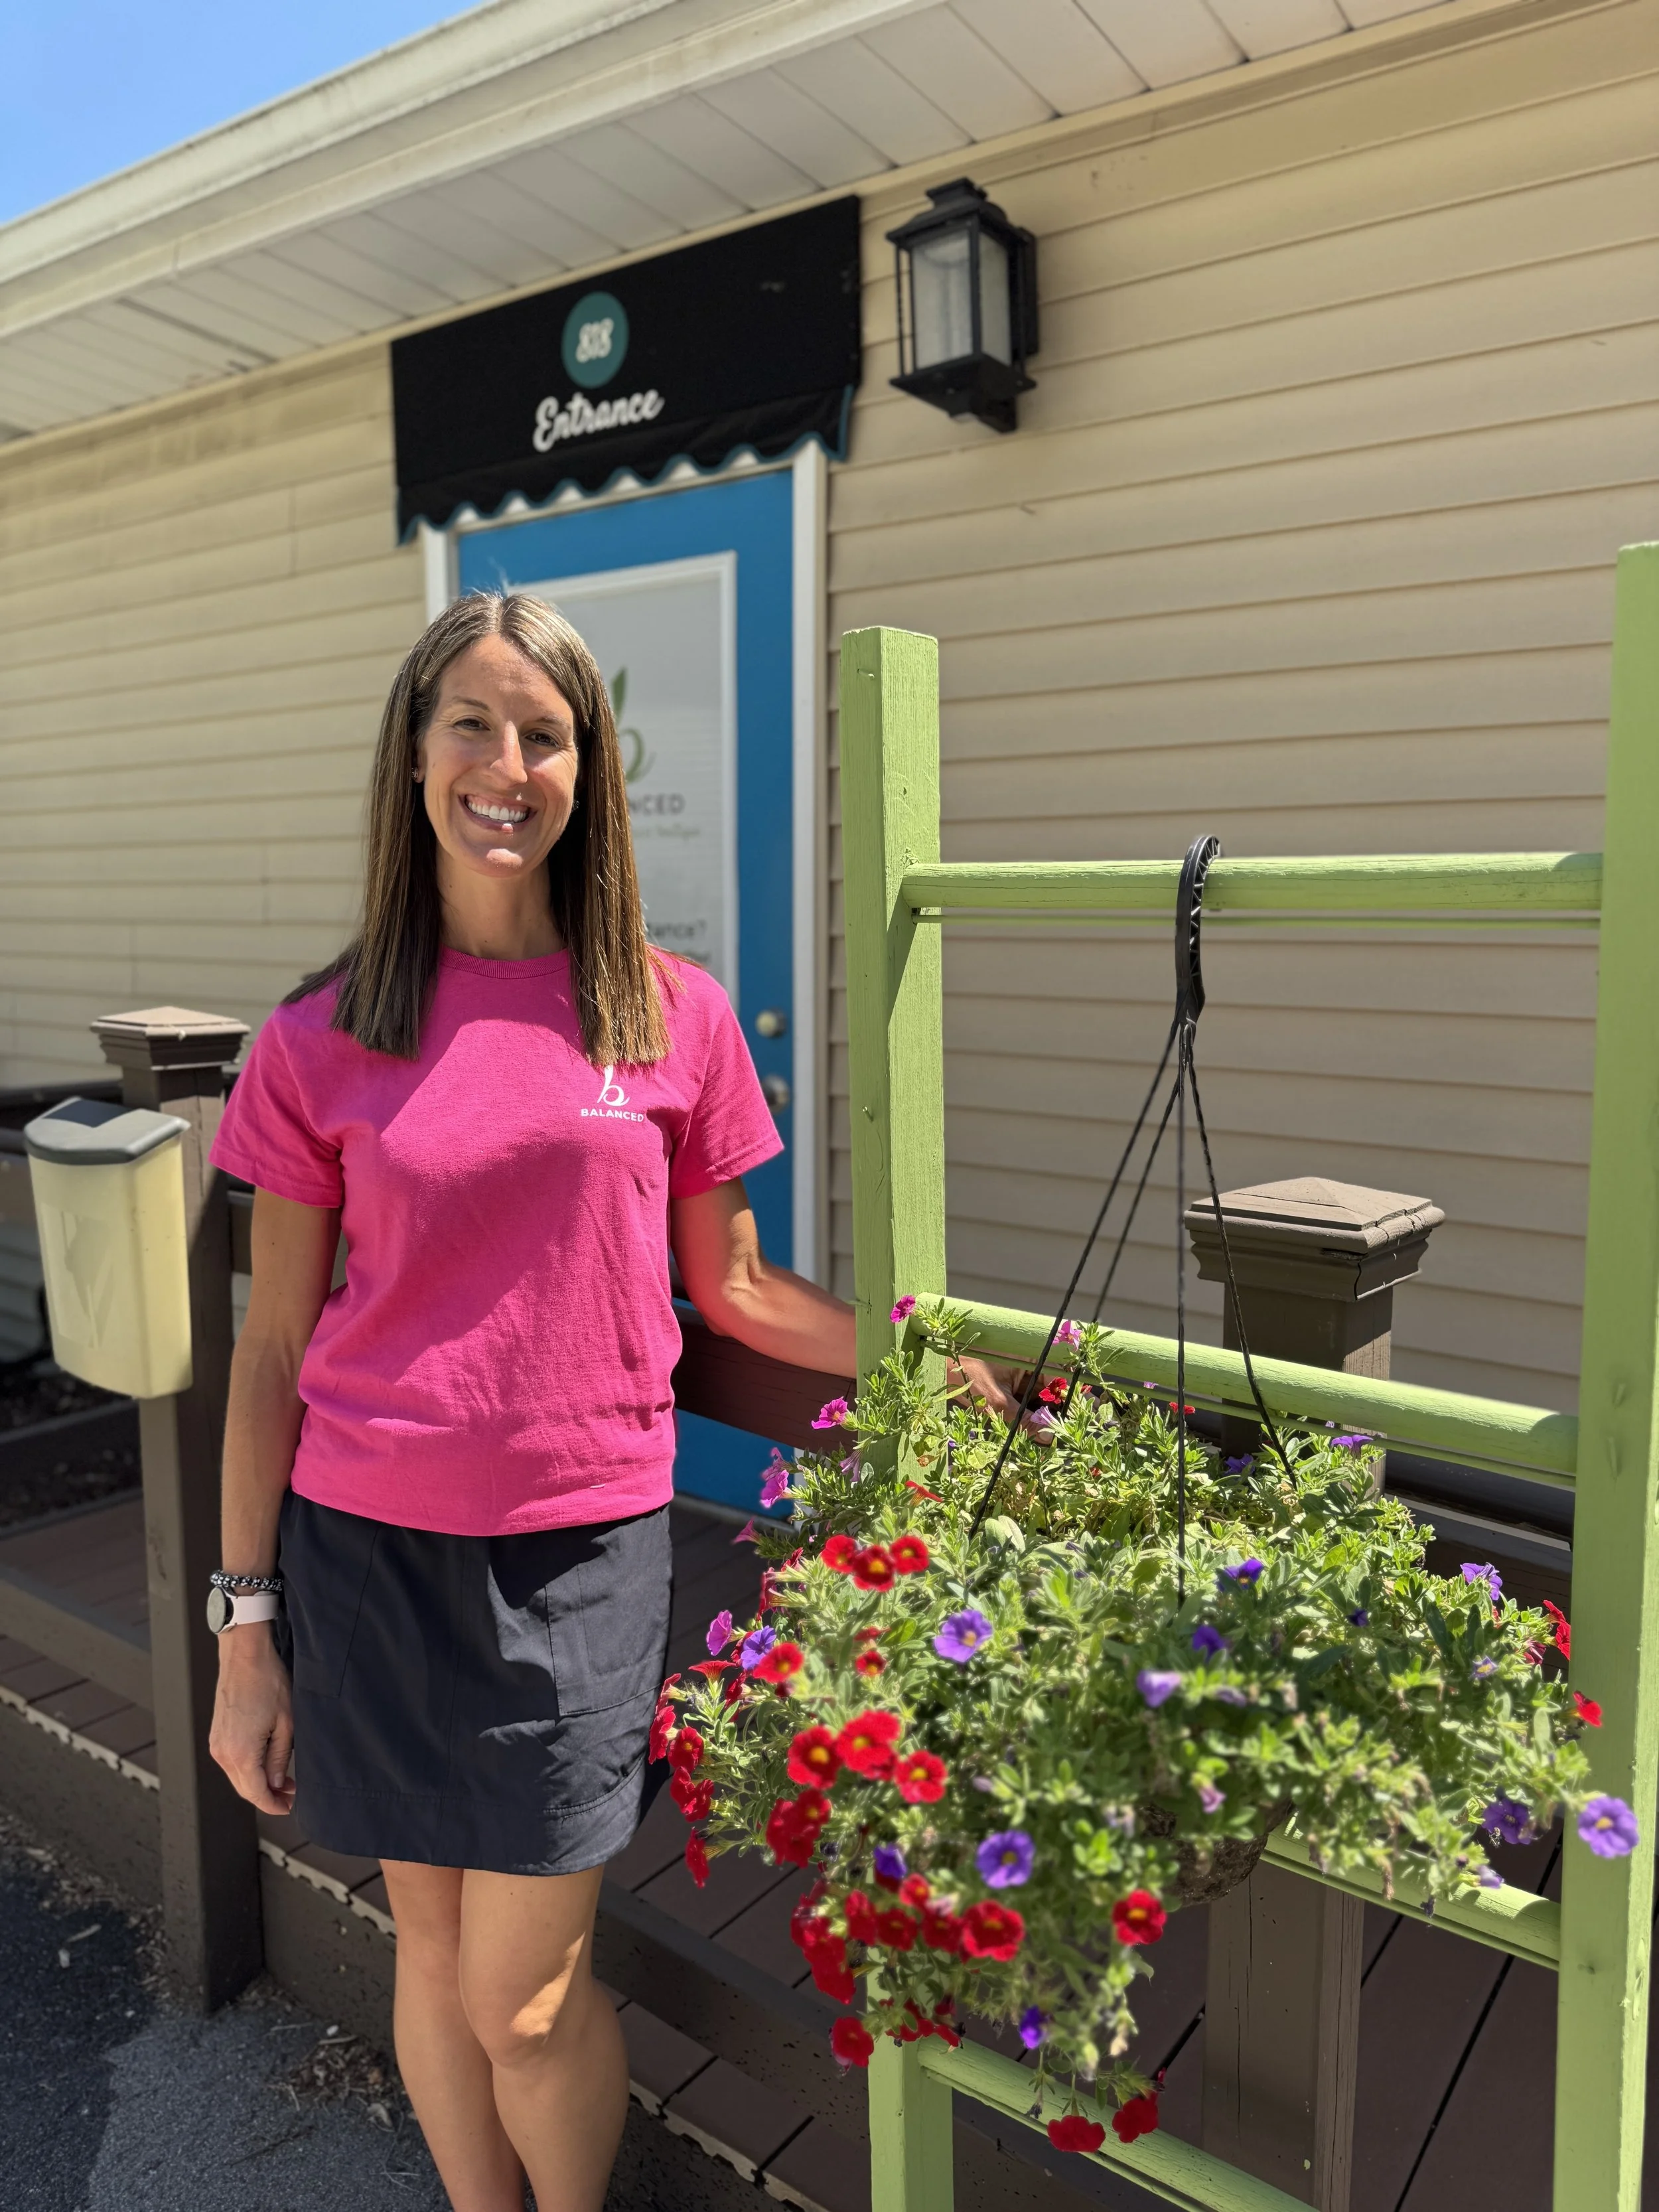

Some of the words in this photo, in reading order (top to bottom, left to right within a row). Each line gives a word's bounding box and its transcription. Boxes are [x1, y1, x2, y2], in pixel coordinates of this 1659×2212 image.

[533, 389, 666, 452] Entrance
[628, 792, 687, 816] NCED
[581, 1108, 644, 1122] BALANCED
